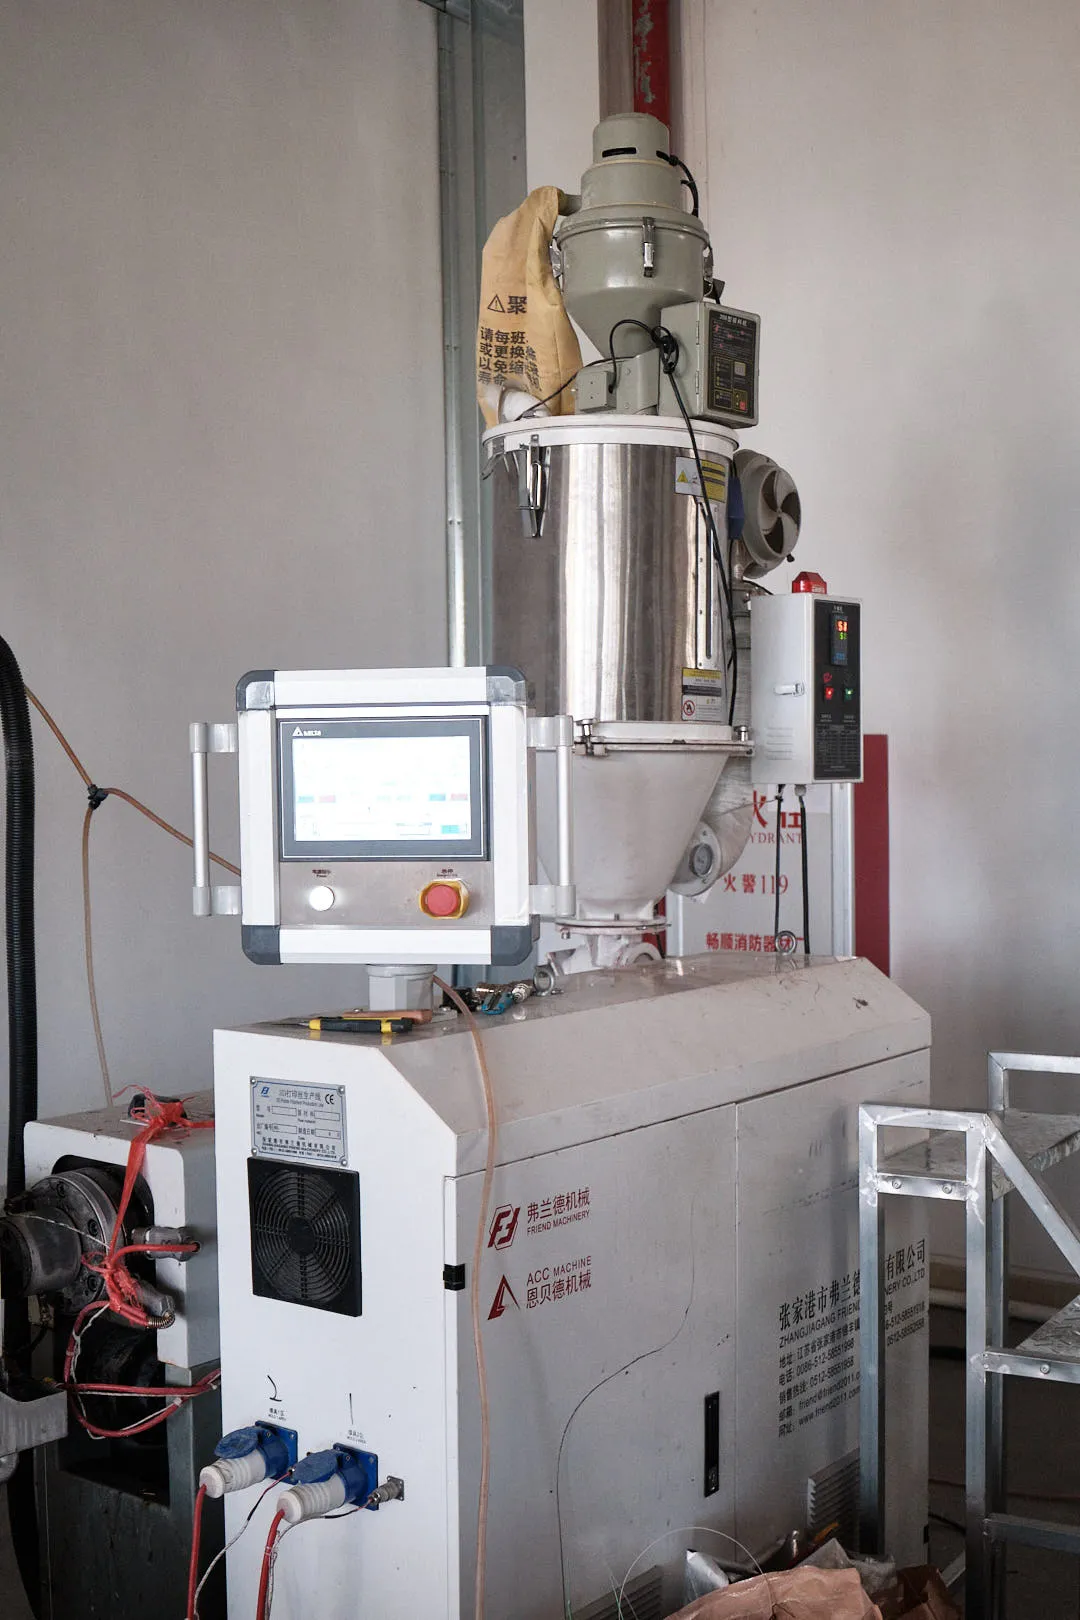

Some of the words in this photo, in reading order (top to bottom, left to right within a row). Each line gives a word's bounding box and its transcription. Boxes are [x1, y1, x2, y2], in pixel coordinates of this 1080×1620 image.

[507, 296, 527, 314] 聚
[527, 1187, 590, 1223] 弗兰德机械
[526, 1220, 552, 1237] FRIEND
[553, 1209, 590, 1229] MACHINERY
[526, 1267, 550, 1287] ACC
[553, 1255, 591, 1277] MACHINE
[526, 1270, 591, 1309] 恩贝德机械
[779, 1312, 836, 1348] ZHANGJIAGANG
